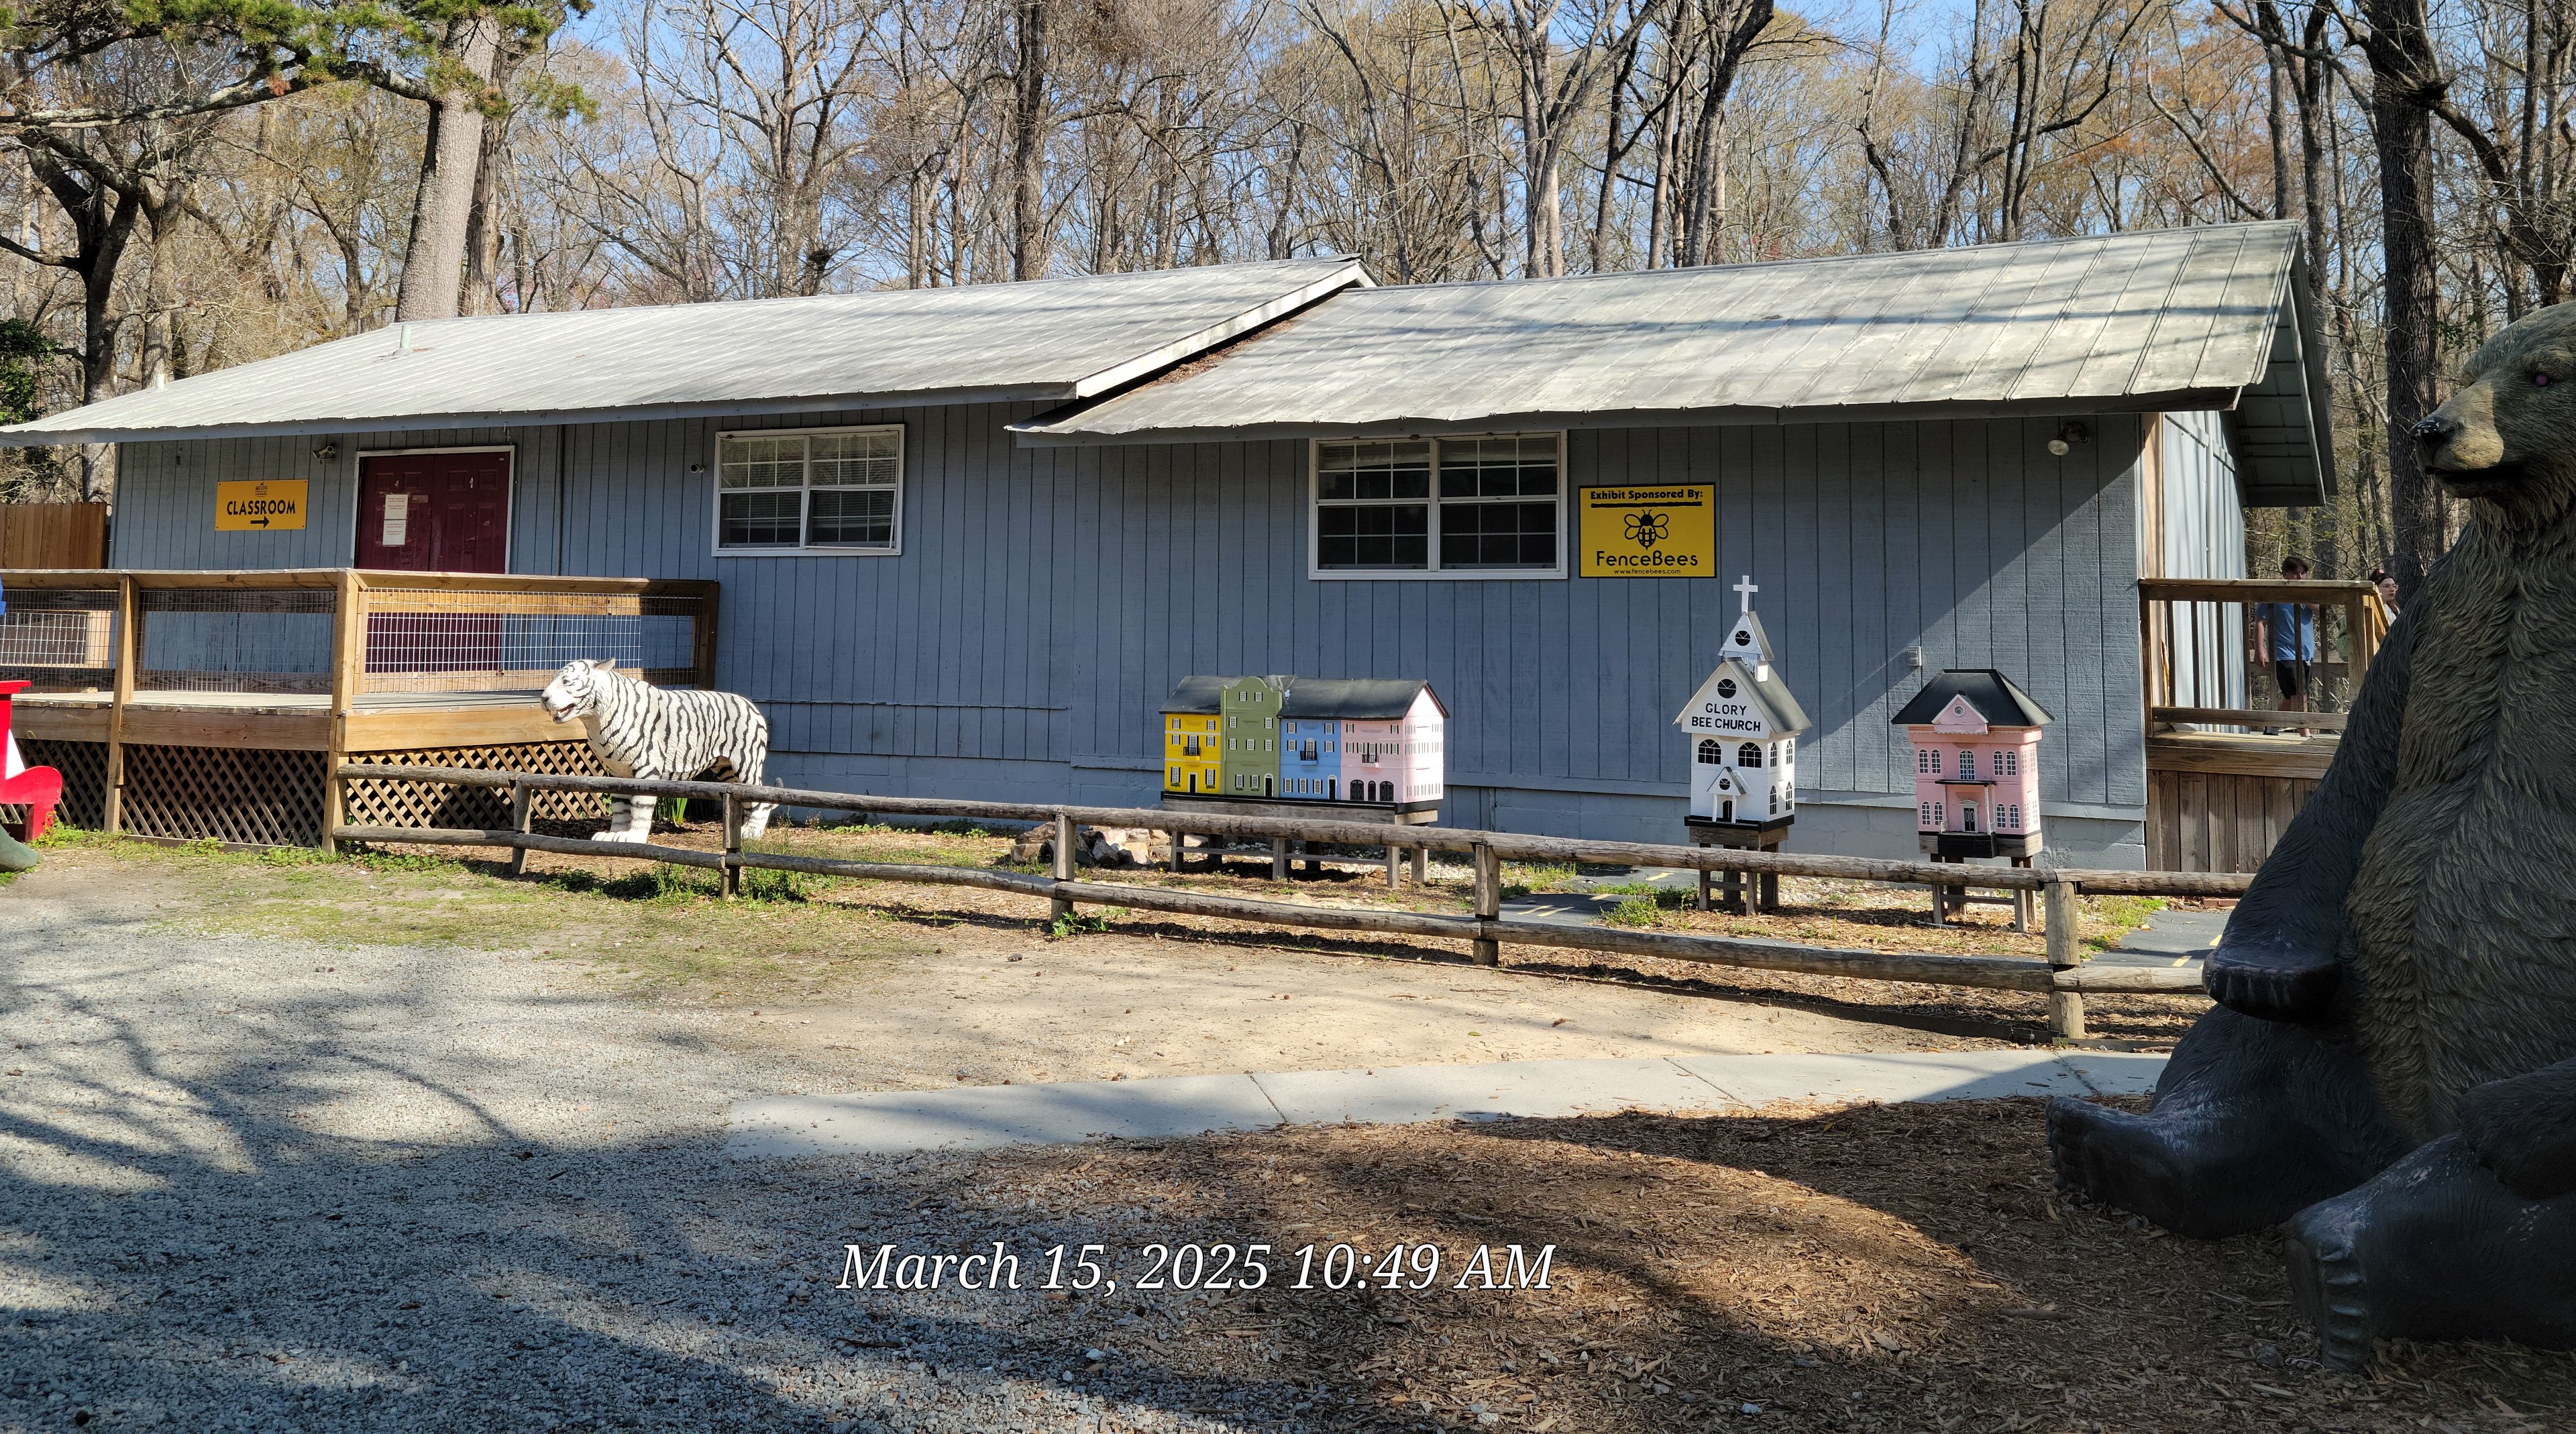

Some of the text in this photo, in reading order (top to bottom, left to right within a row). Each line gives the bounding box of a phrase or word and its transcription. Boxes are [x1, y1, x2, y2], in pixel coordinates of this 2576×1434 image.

[1591, 489, 1703, 501] Exhibit Sponsored By:
[227, 499, 296, 515] CLASSROOM
[1597, 550, 1698, 566] FenceBees
[1705, 703, 1748, 716] GLORY
[1691, 716, 1761, 731] BEE CHURCH
